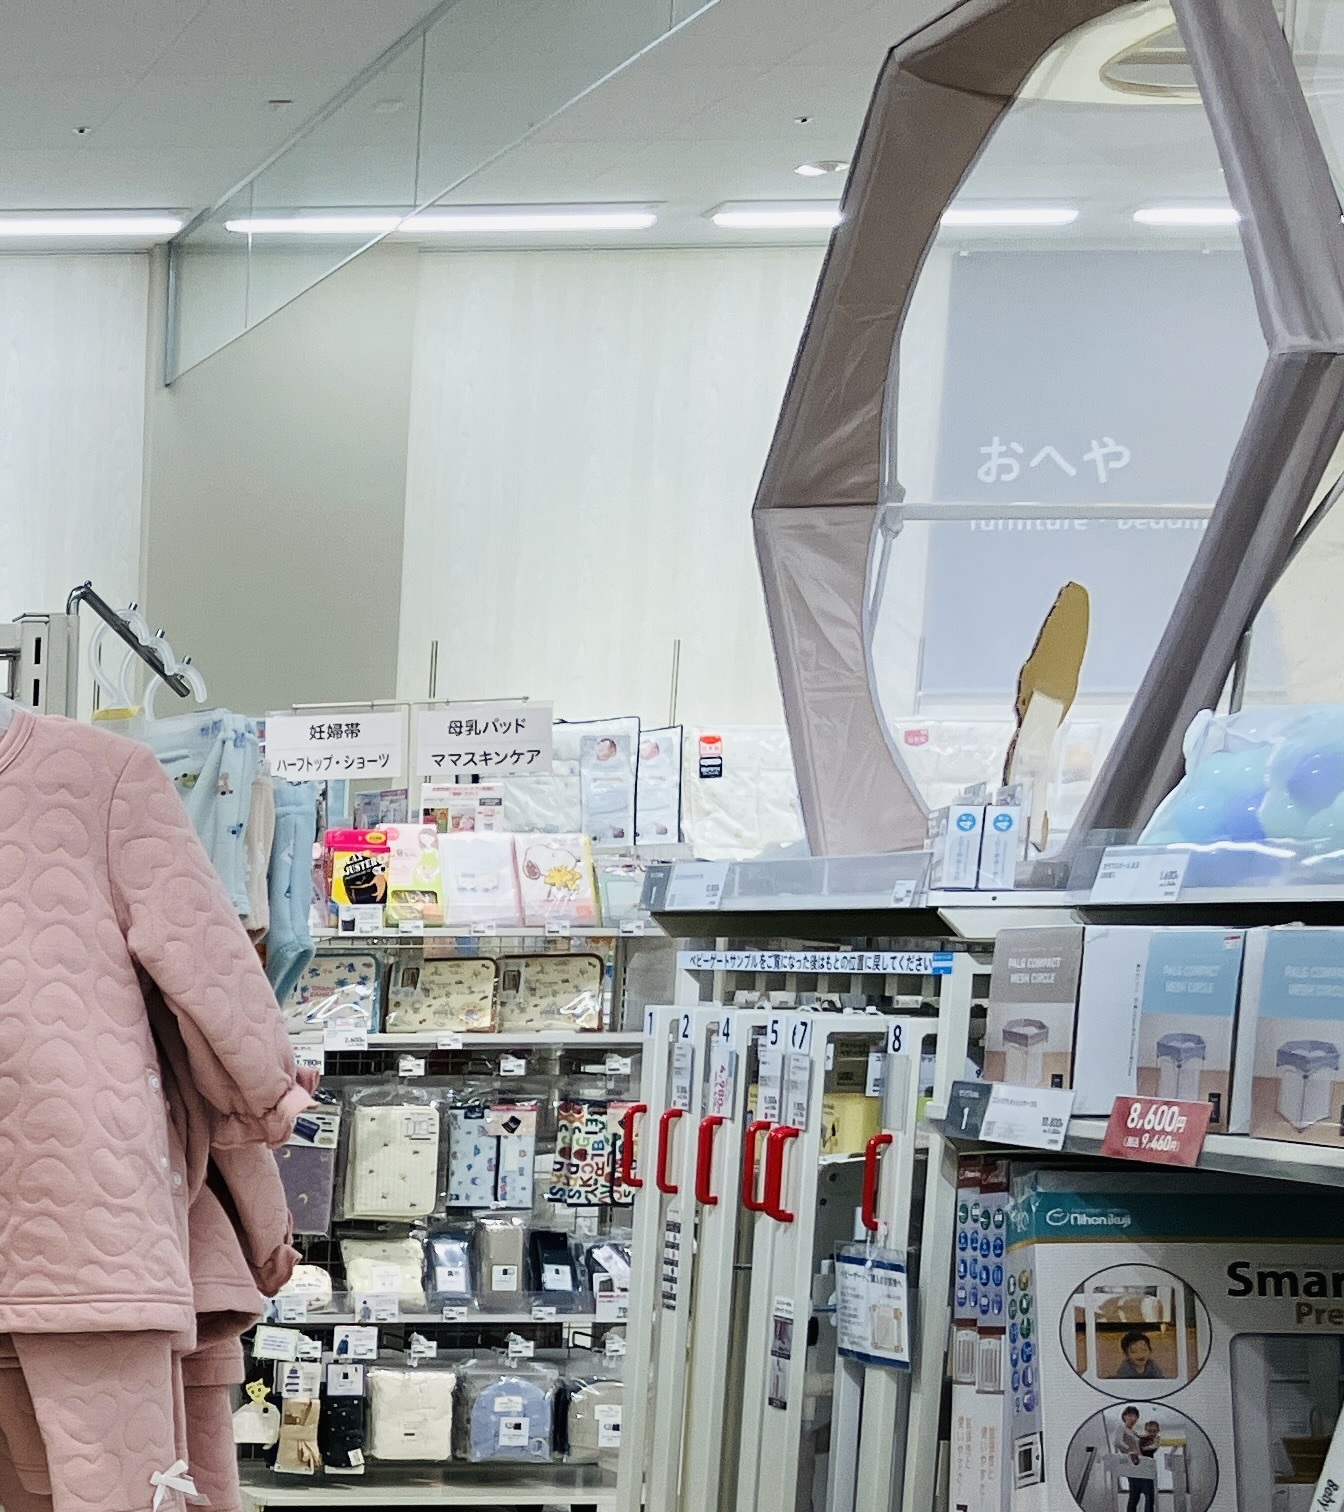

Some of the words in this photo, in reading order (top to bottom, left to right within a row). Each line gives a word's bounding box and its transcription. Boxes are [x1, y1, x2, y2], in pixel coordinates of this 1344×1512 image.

[977, 436, 1131, 484] おへや
[309, 722, 361, 740] 妊婦帯
[448, 718, 527, 737] 母乳パッド
[431, 749, 541, 768] ママスキンケア
[648, 1012, 653, 1035] 1
[682, 1014, 689, 1039] 2
[722, 1017, 730, 1043] 4
[770, 1020, 779, 1045] 5
[799, 1021, 808, 1050] 7
[892, 1025, 902, 1052] 8
[961, 1107, 969, 1130] 1
[1127, 1102, 1187, 1133] 8,600円
